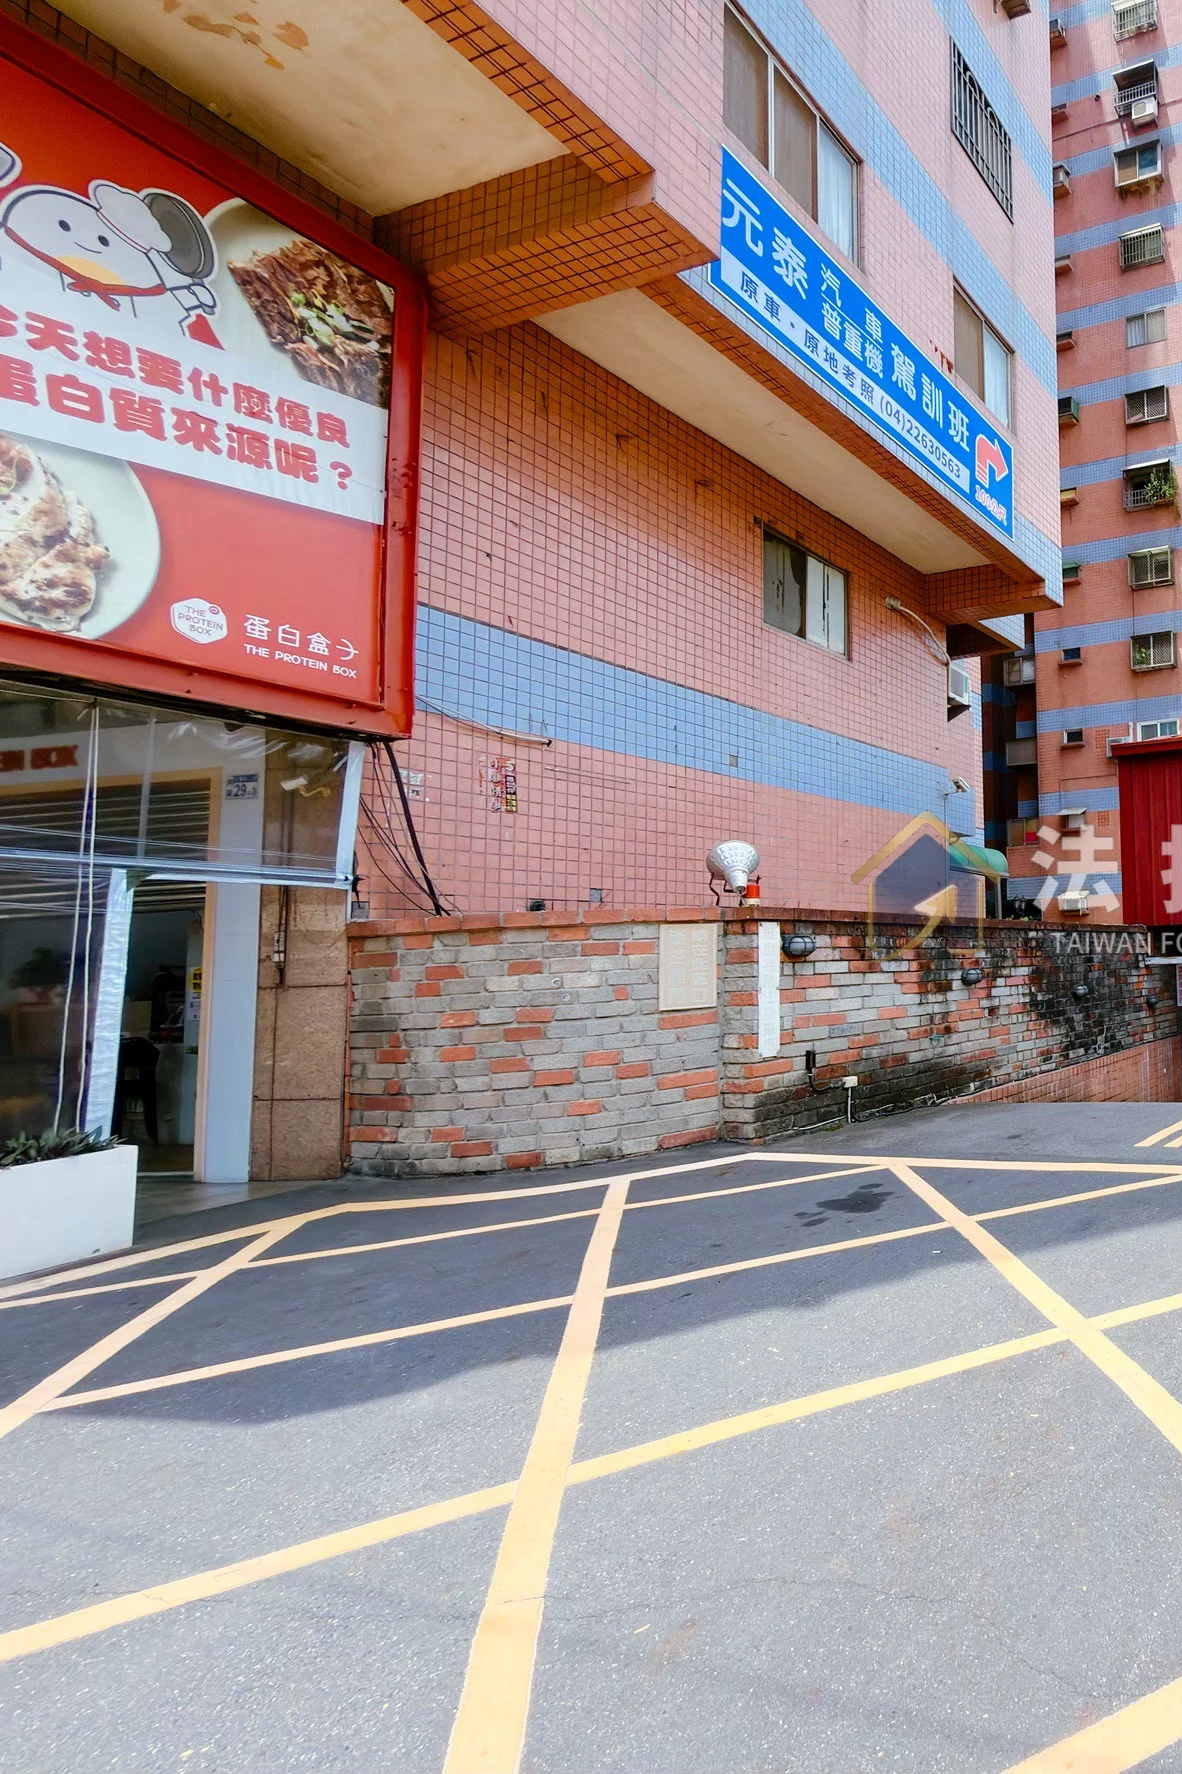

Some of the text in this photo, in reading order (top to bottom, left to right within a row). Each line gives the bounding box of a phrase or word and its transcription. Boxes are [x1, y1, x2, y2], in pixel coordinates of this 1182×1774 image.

[722, 178, 808, 299] 元泰
[821, 263, 883, 344] 汽車
[822, 302, 883, 379] 普重機
[891, 343, 970, 452] 駕訓班
[880, 399, 961, 478] (04)22630563
[178, 612, 223, 631] PROTEIN
[185, 605, 206, 617] THE
[189, 624, 212, 636] BOX
[244, 614, 331, 655] 蛋白盒
[244, 643, 357, 678] THE PROTEIN BOX
